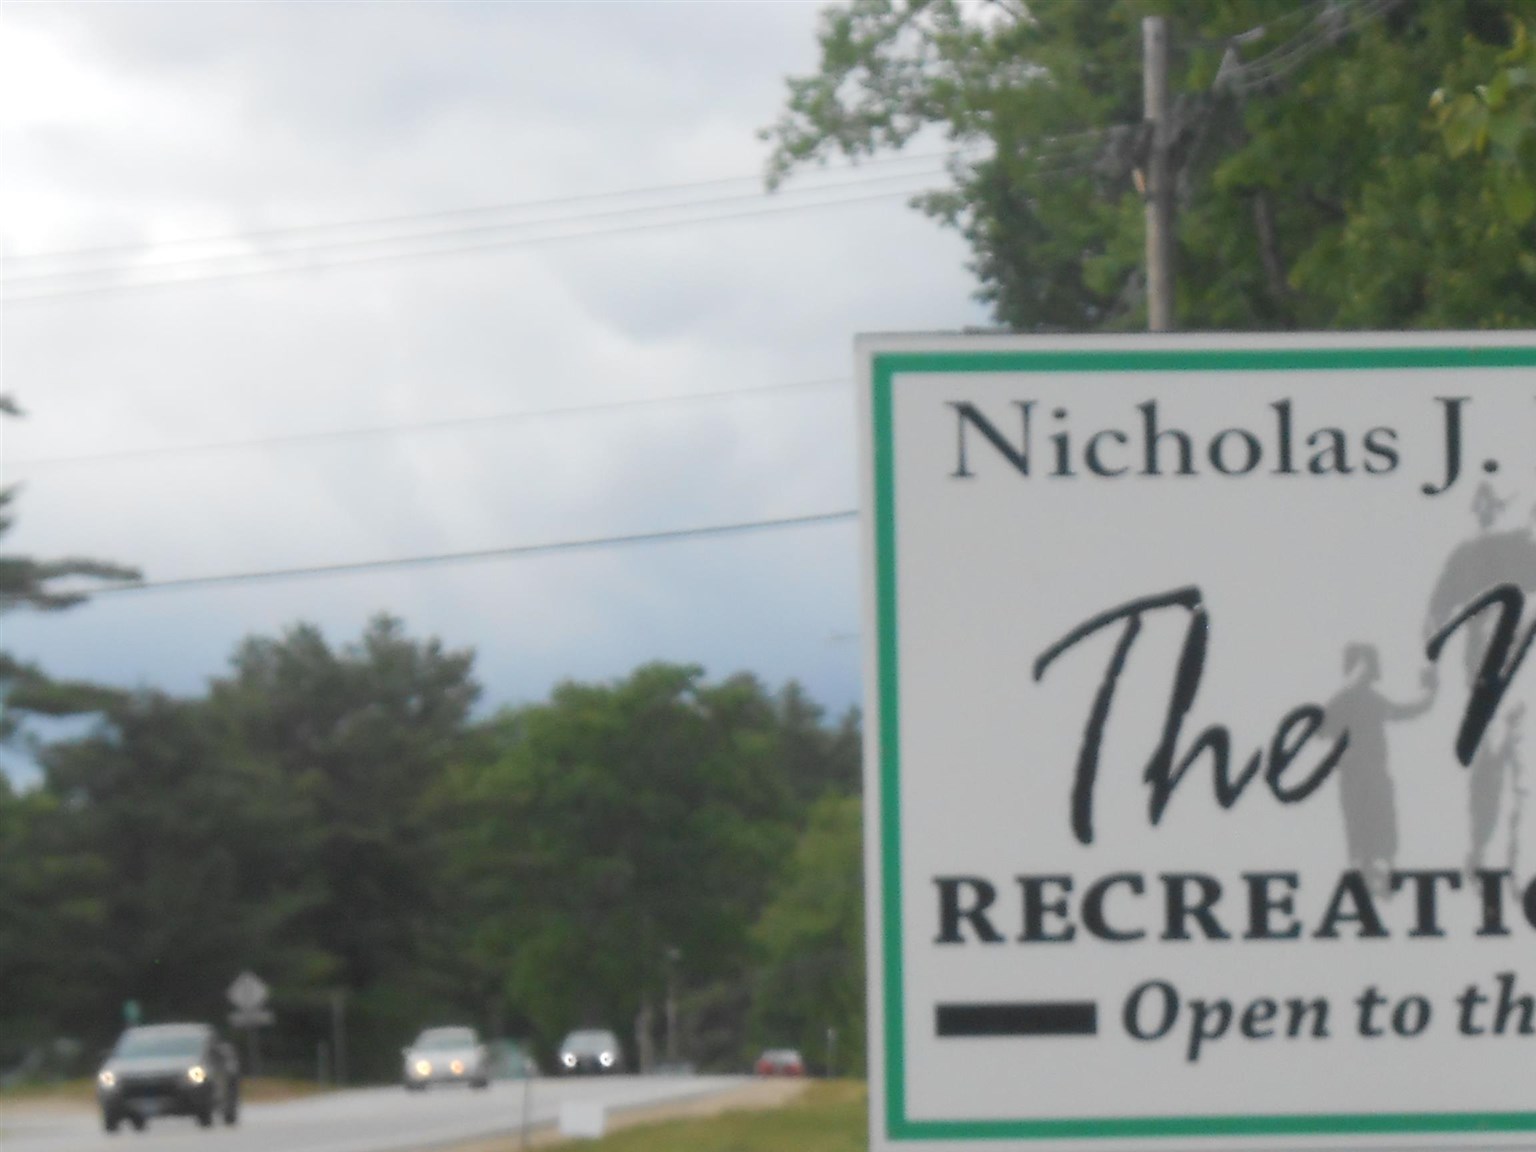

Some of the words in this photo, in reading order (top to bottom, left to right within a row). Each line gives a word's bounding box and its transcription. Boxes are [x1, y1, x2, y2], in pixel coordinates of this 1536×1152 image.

[948, 399, 1399, 480] Nicholas
[1421, 396, 1500, 497] J.
[1031, 584, 1350, 846] The
[1121, 979, 1330, 1063] Open
[1355, 986, 1433, 1038] to
